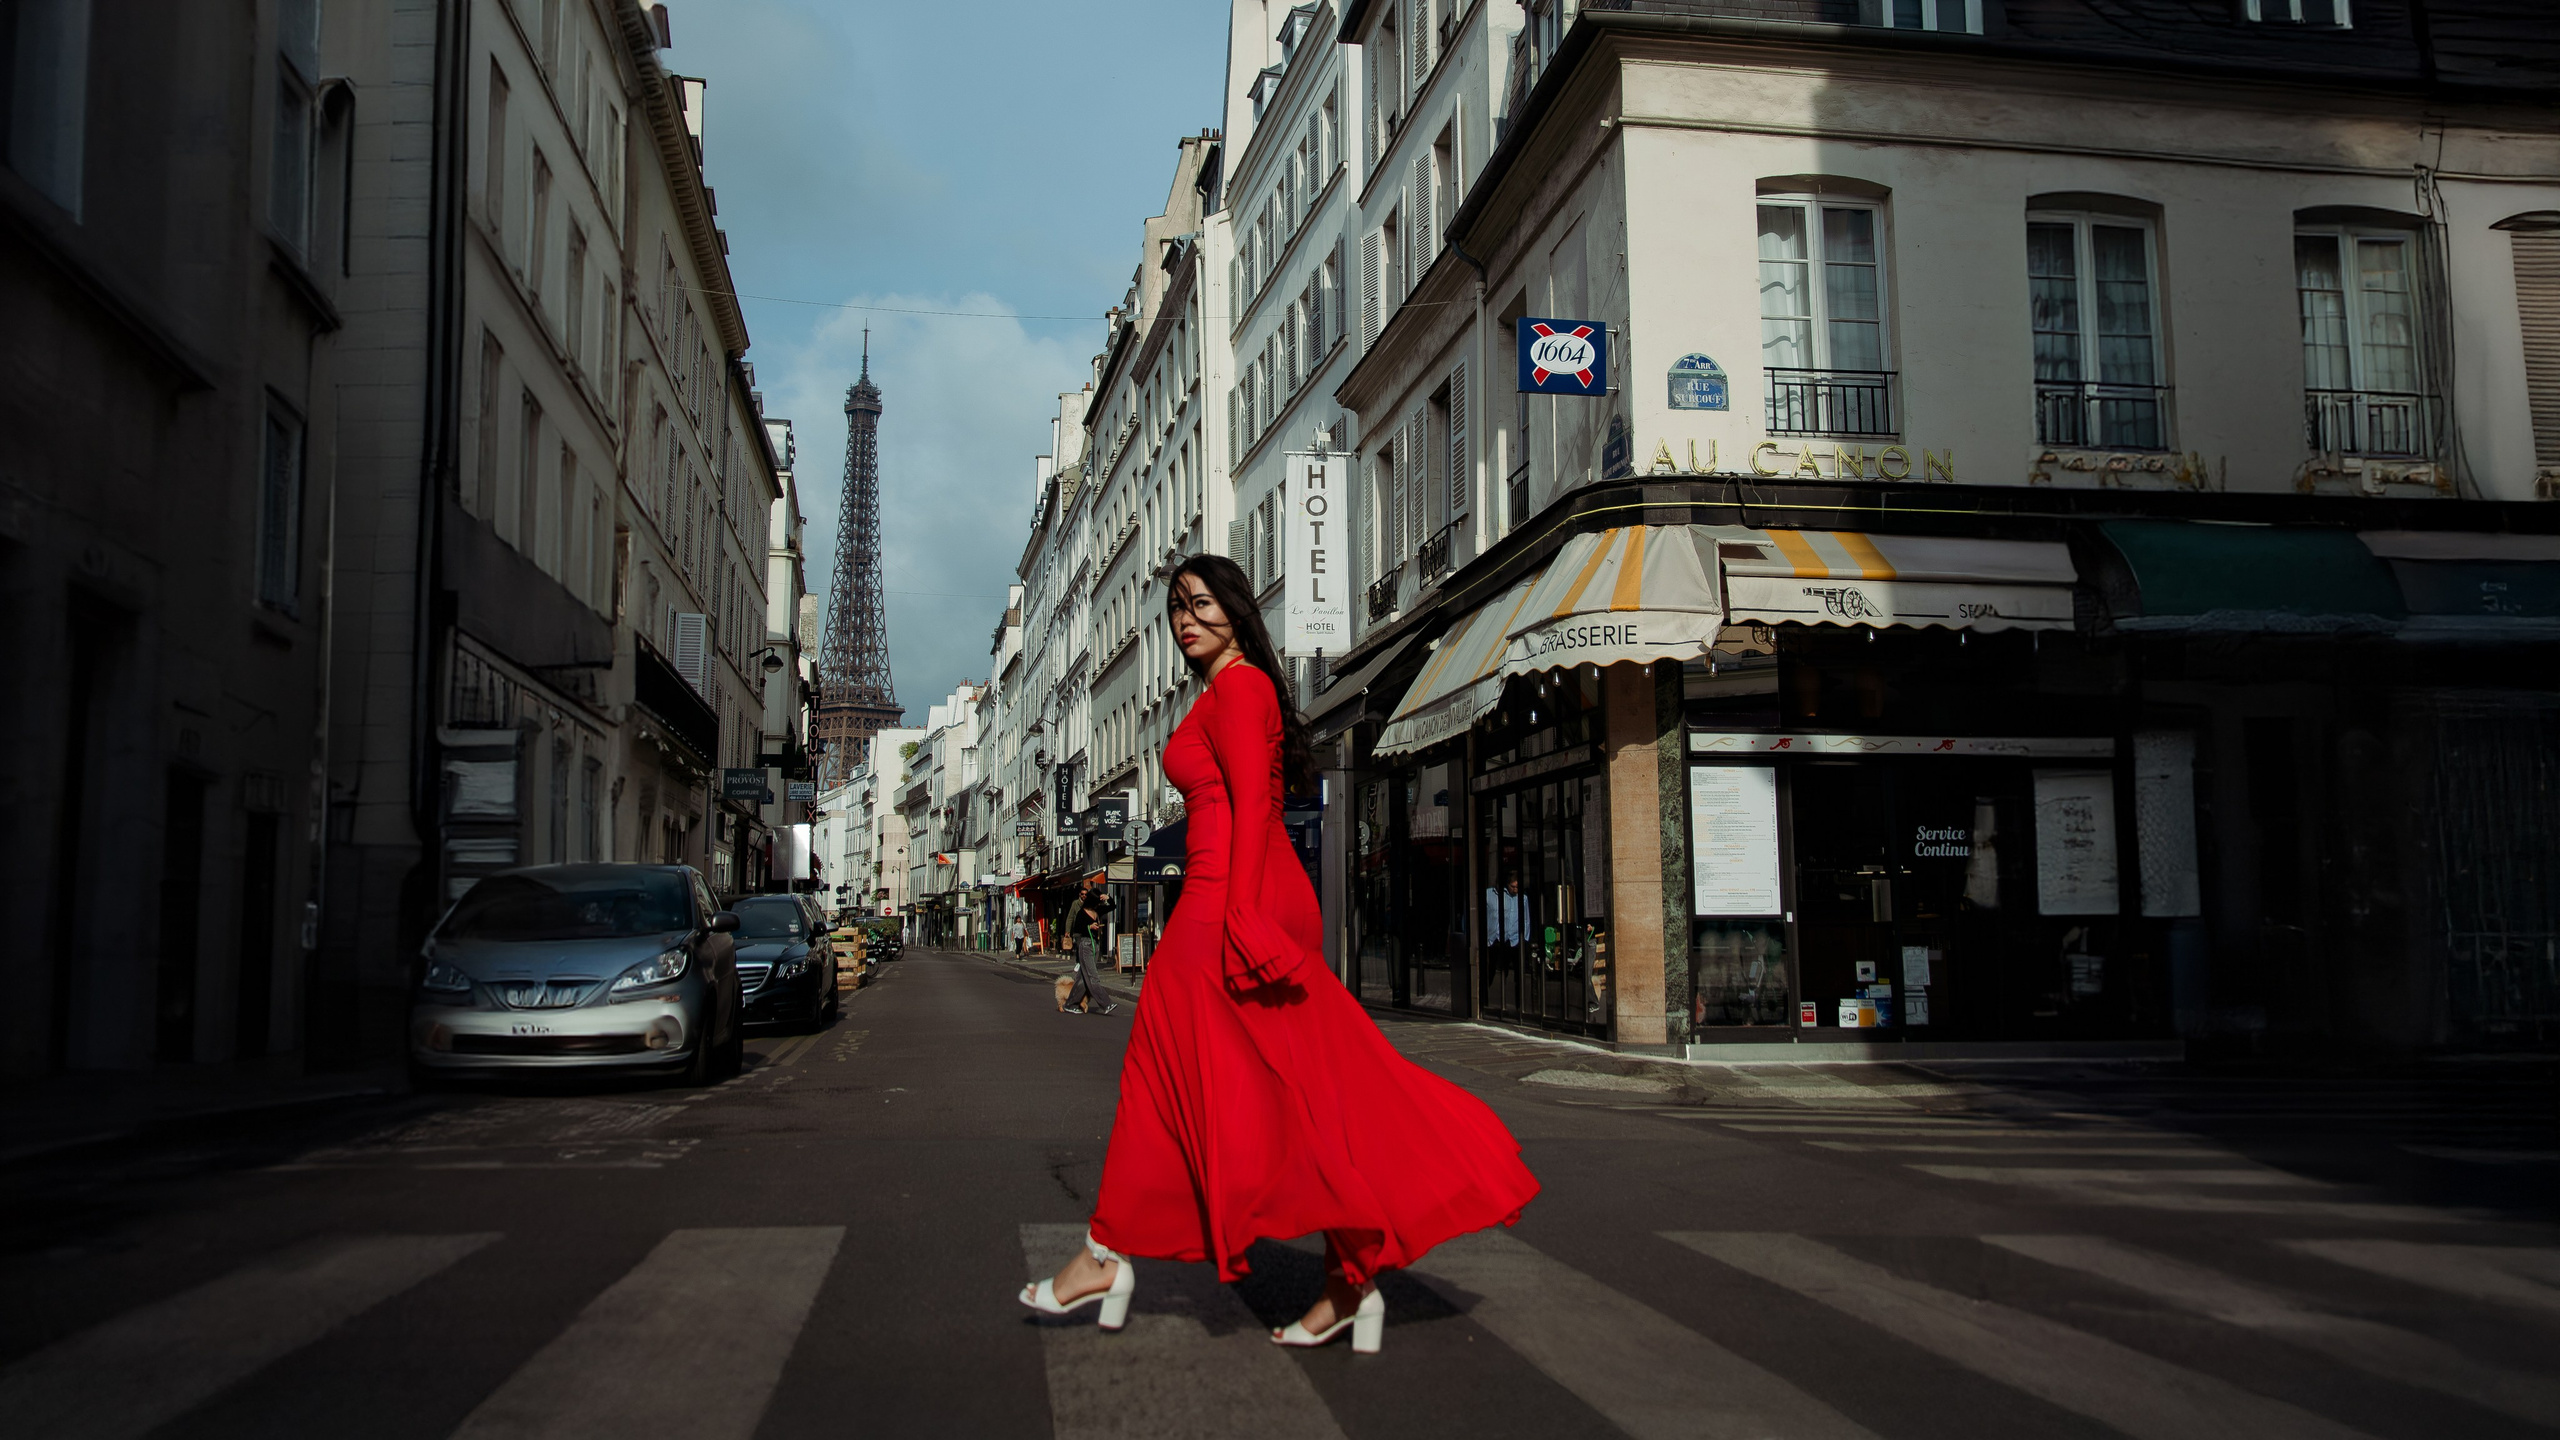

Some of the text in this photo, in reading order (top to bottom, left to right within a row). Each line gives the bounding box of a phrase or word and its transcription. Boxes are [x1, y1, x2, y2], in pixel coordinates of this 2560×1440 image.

[1537, 339, 1588, 365] 1664
[1687, 382, 1710, 392] RUE
[1674, 393, 1722, 404] SURCOUF
[1646, 437, 1954, 484] AU CANON
[1305, 464, 1328, 603] HOTEL
[1312, 605, 1345, 615] Pavillon
[1306, 623, 1336, 631] HOTEL
[1540, 625, 1638, 655] BRASSERIE
[805, 695, 820, 822] THOUMIUX
[727, 776, 766, 784] PROVOST
[1915, 825, 1967, 840] Service
[1914, 841, 1971, 857] Continu
